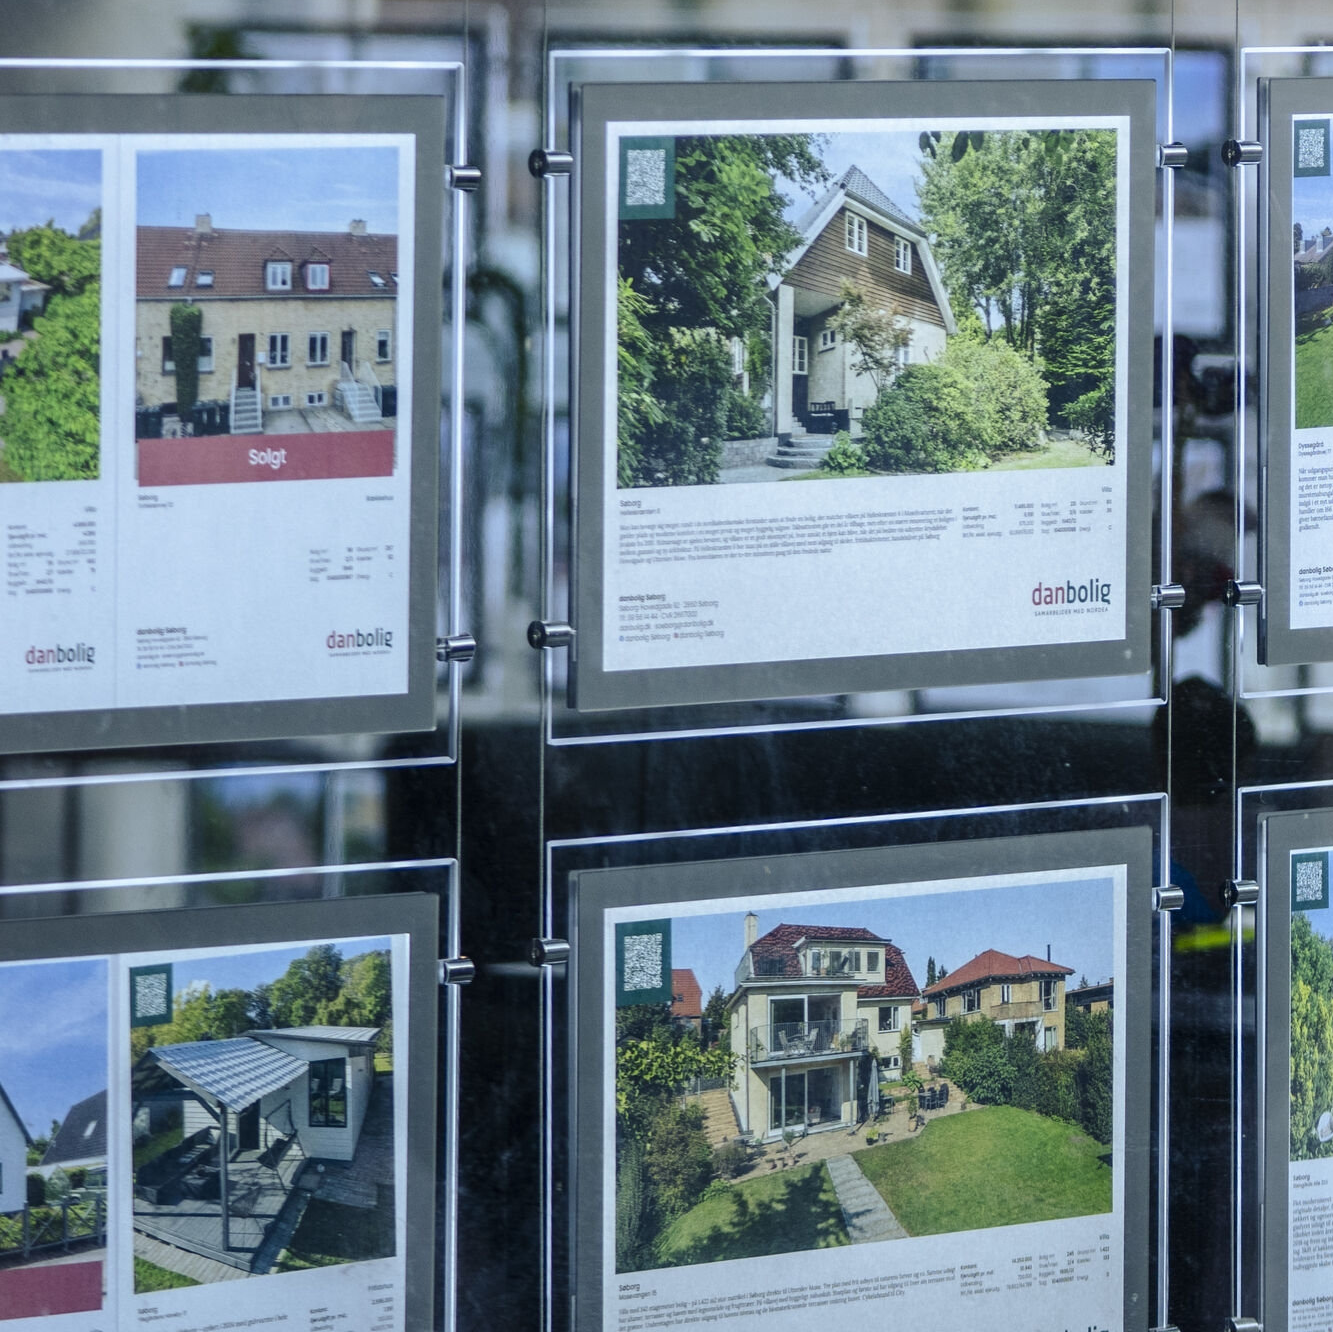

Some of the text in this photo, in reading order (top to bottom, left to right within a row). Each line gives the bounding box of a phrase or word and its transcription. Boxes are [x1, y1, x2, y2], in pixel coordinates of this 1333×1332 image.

[249, 448, 287, 469] Solgt
[1299, 566, 1322, 575] danbolig
[1032, 578, 1111, 606] danbolig
[327, 628, 393, 649] danbolig
[26, 643, 95, 664] danbolig
